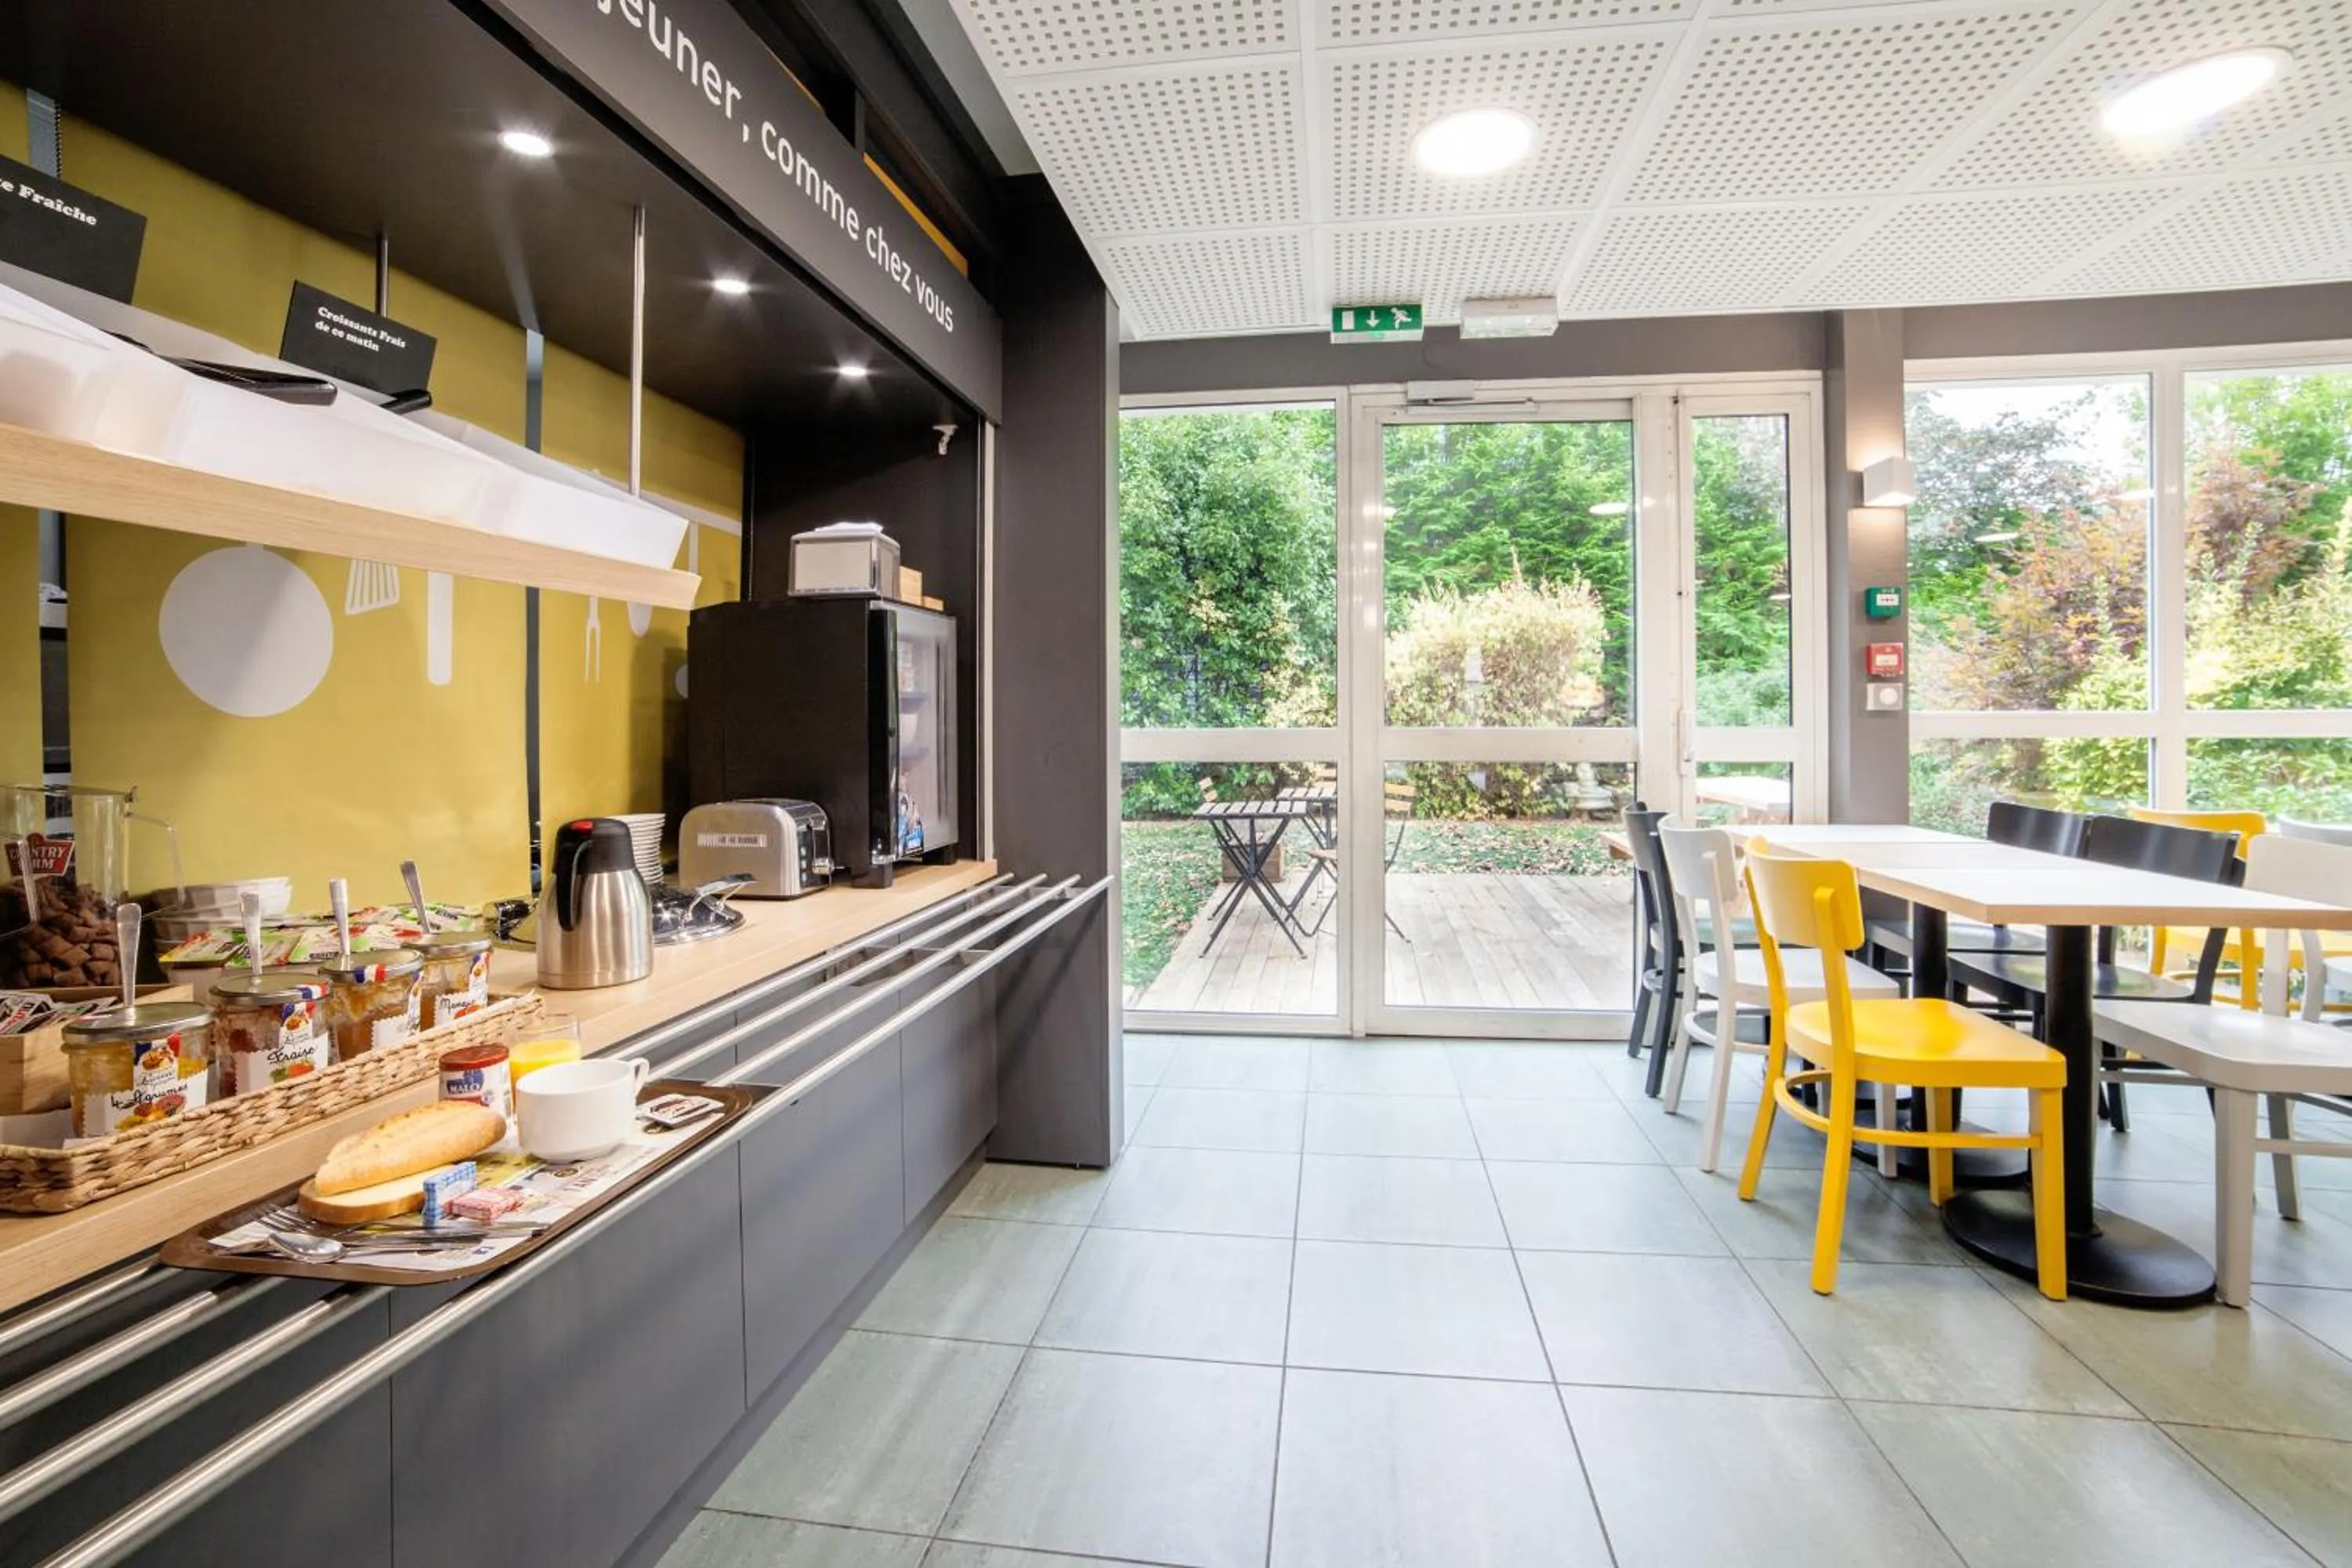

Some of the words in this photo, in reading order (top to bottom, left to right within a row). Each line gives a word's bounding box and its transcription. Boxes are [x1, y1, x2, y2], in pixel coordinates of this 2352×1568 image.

[597, 0, 750, 143] euner,
[761, 121, 860, 241] comme
[866, 226, 912, 294] chez
[916, 274, 953, 332] vous
[18, 184, 96, 226] Fraîche
[314, 321, 330, 332] de
[331, 328, 345, 338] ce
[346, 333, 380, 352] matin
[318, 307, 378, 337] Croissants
[379, 330, 406, 348] Frais
[267, 1046, 315, 1065] Fraise
